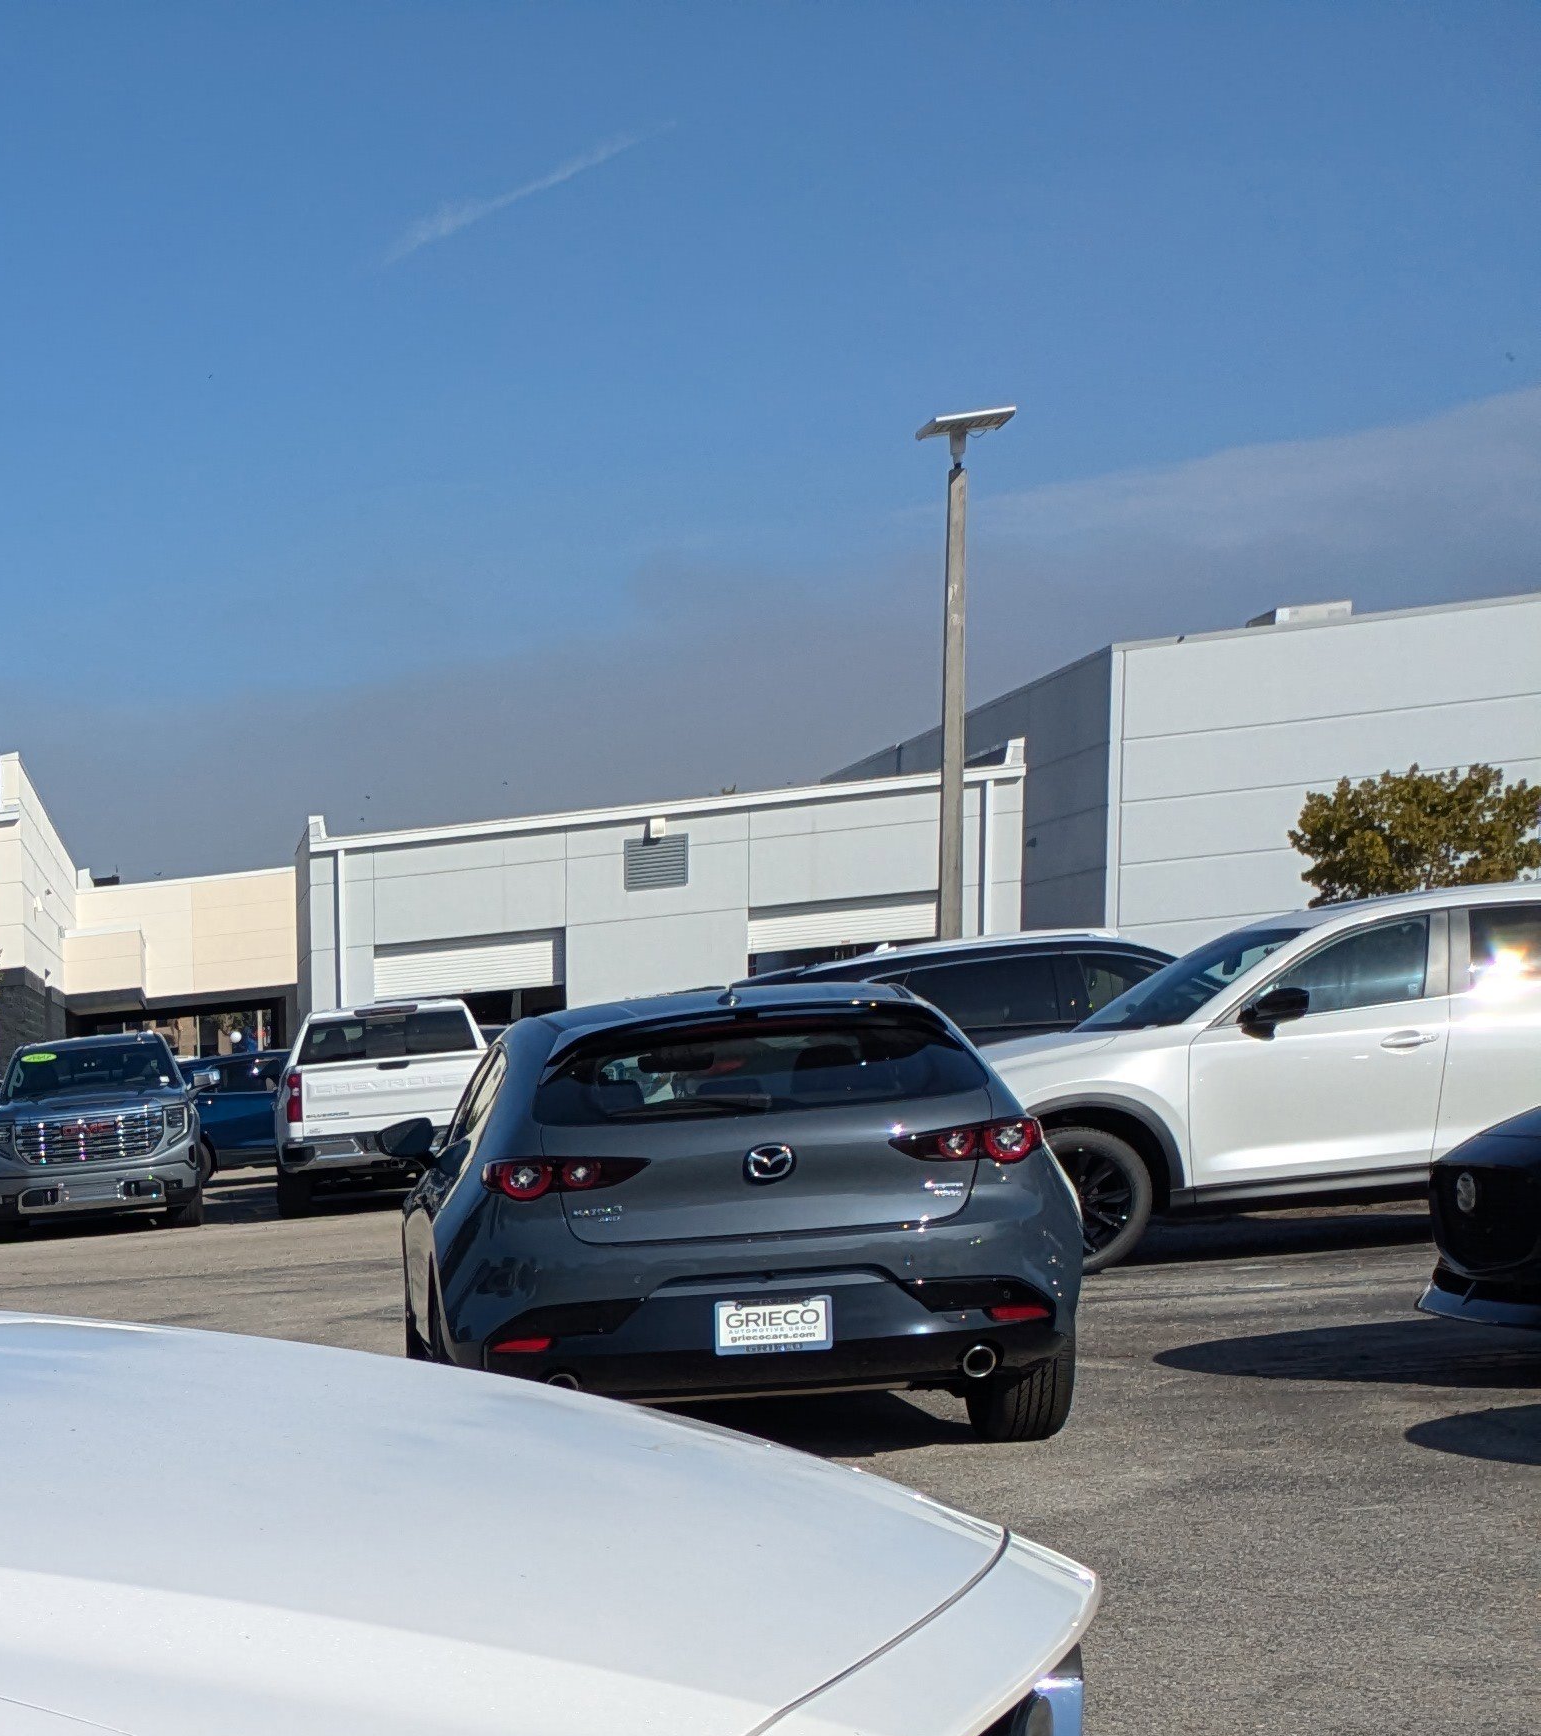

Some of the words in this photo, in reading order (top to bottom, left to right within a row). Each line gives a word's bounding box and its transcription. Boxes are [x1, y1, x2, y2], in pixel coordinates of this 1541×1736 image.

[314, 1073, 470, 1095] CHEVROLE
[725, 1308, 820, 1329] GRIECO
[728, 1327, 785, 1335] AUTOMOTIVE
[730, 1331, 816, 1343] griecocars.com
